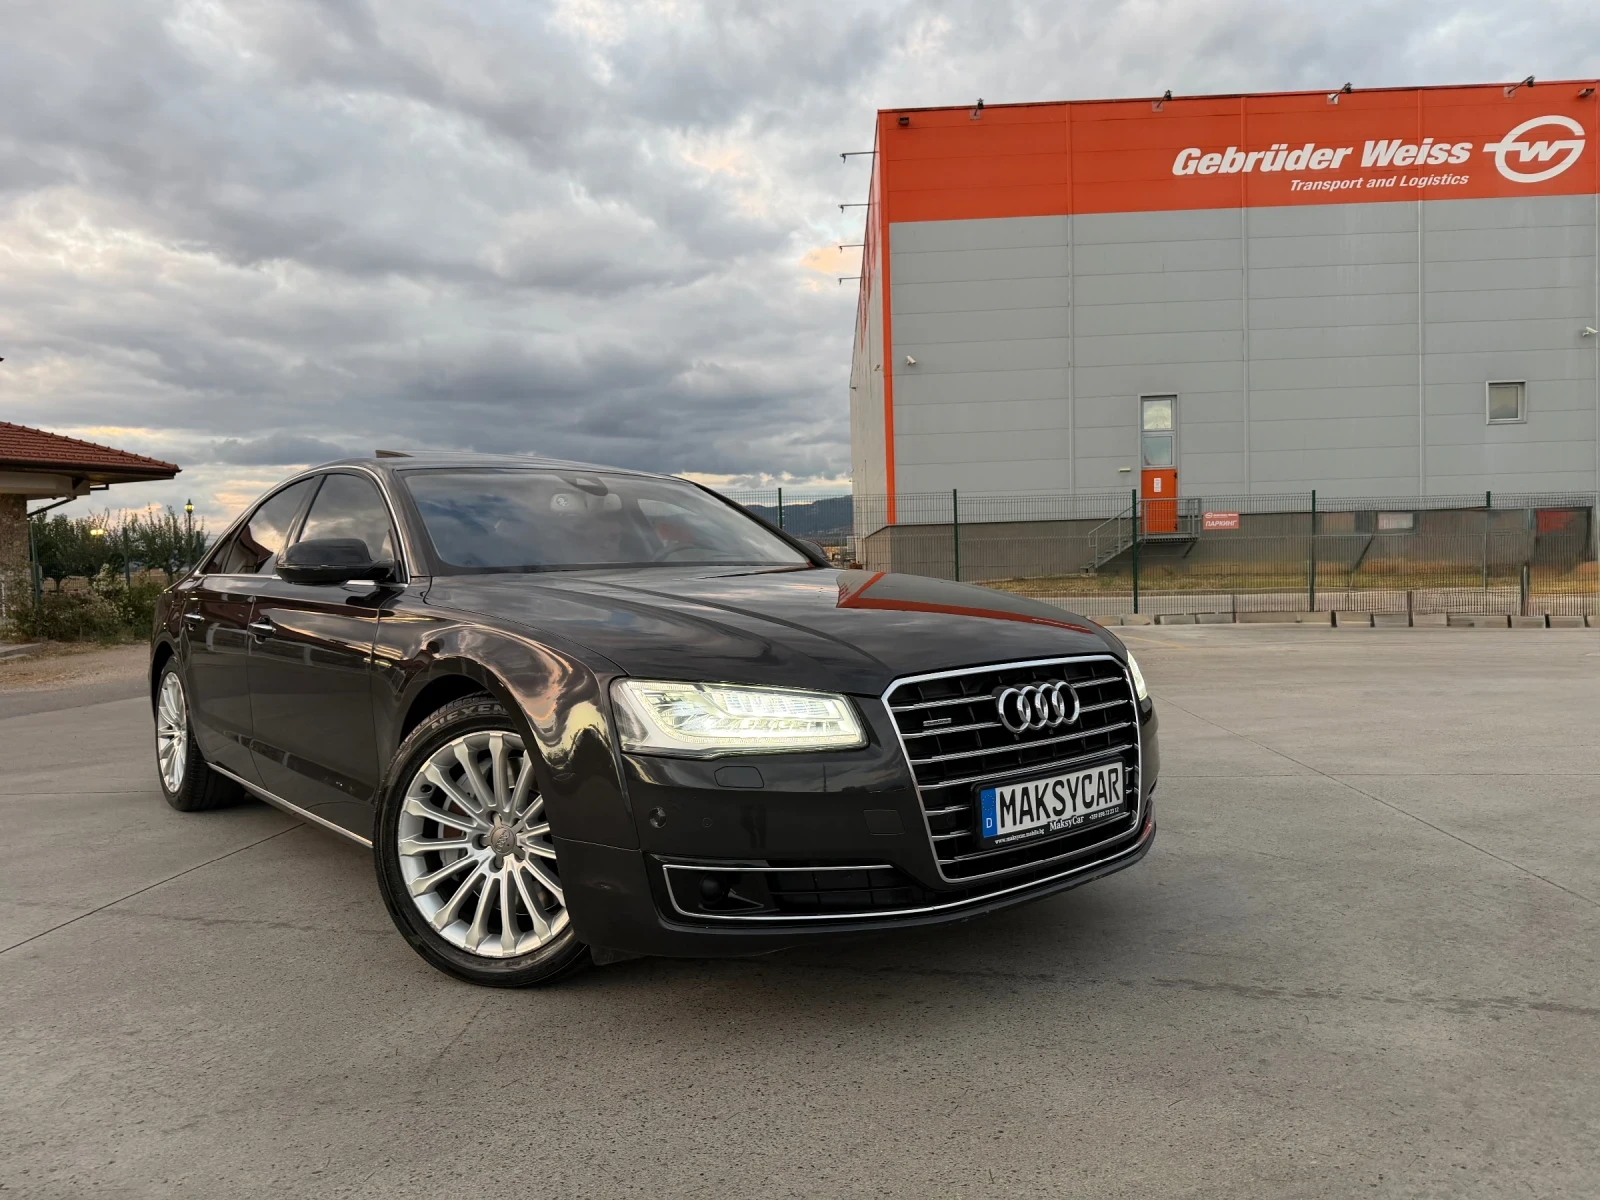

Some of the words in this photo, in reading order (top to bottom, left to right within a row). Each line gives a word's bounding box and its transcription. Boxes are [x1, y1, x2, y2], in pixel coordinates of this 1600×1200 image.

[1172, 143, 1354, 176] Gebrüder
[1360, 137, 1473, 168] Weiss
[1290, 177, 1364, 192] Transport
[1366, 175, 1397, 188] and
[1399, 173, 1470, 189] Logistics
[1205, 519, 1238, 527] ПАРКИНГ
[1000, 767, 1120, 828] MAKSYCAR
[985, 818, 993, 829] D
[1049, 815, 1084, 831] MaksyCar
